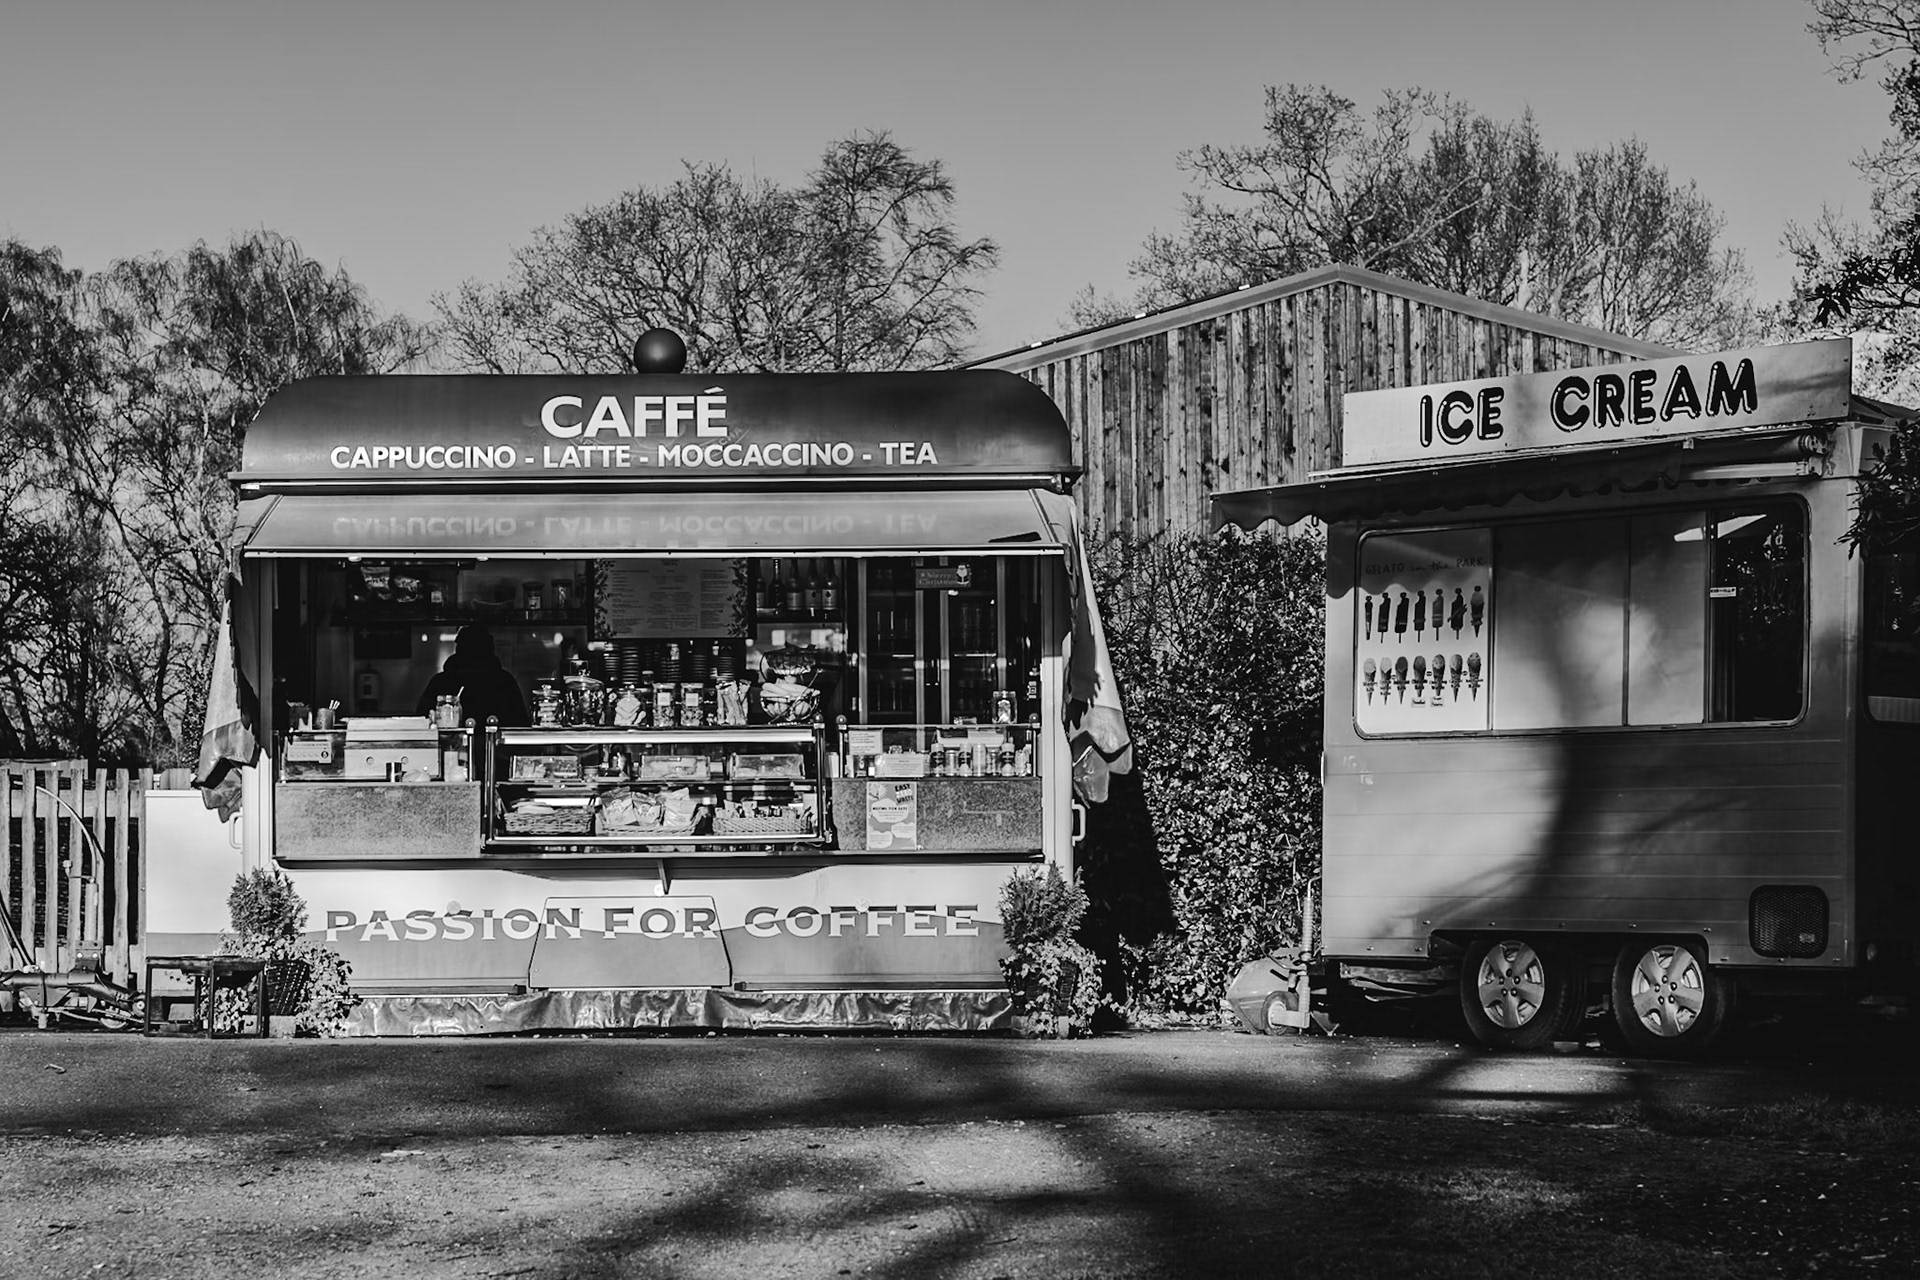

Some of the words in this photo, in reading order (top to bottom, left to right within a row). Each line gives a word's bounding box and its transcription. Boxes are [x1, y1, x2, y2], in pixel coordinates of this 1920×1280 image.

[541, 386, 728, 439] CAFFÉ
[1420, 387, 1504, 447] ICE
[1551, 358, 1758, 432] CREAM
[331, 445, 517, 470] CAPPUCCINO
[543, 445, 631, 469] LATTE
[658, 443, 854, 468] MOCCACCINO
[880, 442, 938, 465] TEA
[1365, 562, 1404, 575] GELATO
[1428, 561, 1452, 571] the
[1456, 557, 1484, 568] PARK
[325, 908, 583, 941] PASSION
[602, 906, 718, 940] FOR
[744, 903, 979, 938] COFFEE
